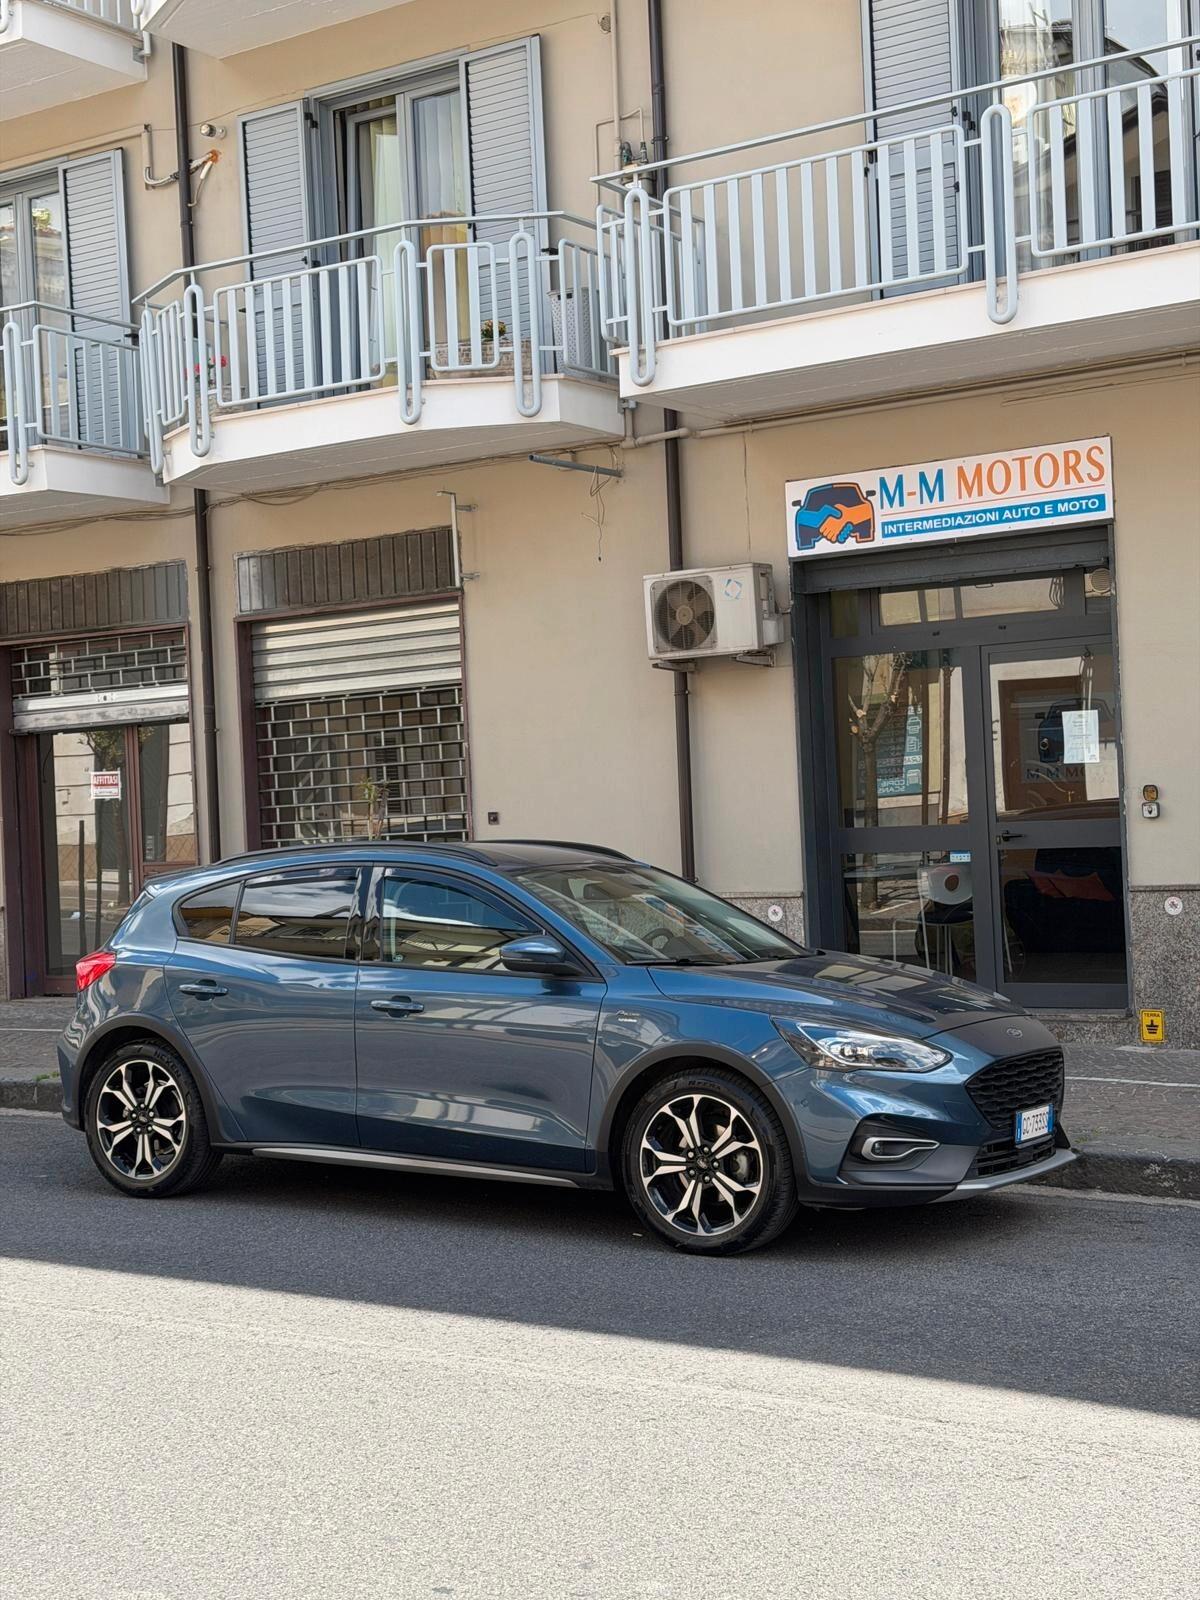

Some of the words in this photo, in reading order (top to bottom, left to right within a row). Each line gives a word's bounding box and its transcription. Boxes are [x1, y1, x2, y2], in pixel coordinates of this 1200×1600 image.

[879, 468, 945, 510] M-M
[957, 445, 1105, 500] MOTORS
[884, 511, 1000, 534] INTERMEDIAZIONI
[1004, 504, 1041, 520] AUTO
[1044, 504, 1053, 515] E
[1060, 498, 1100, 513] MOTO
[93, 775, 118, 784] AFFITTASI
